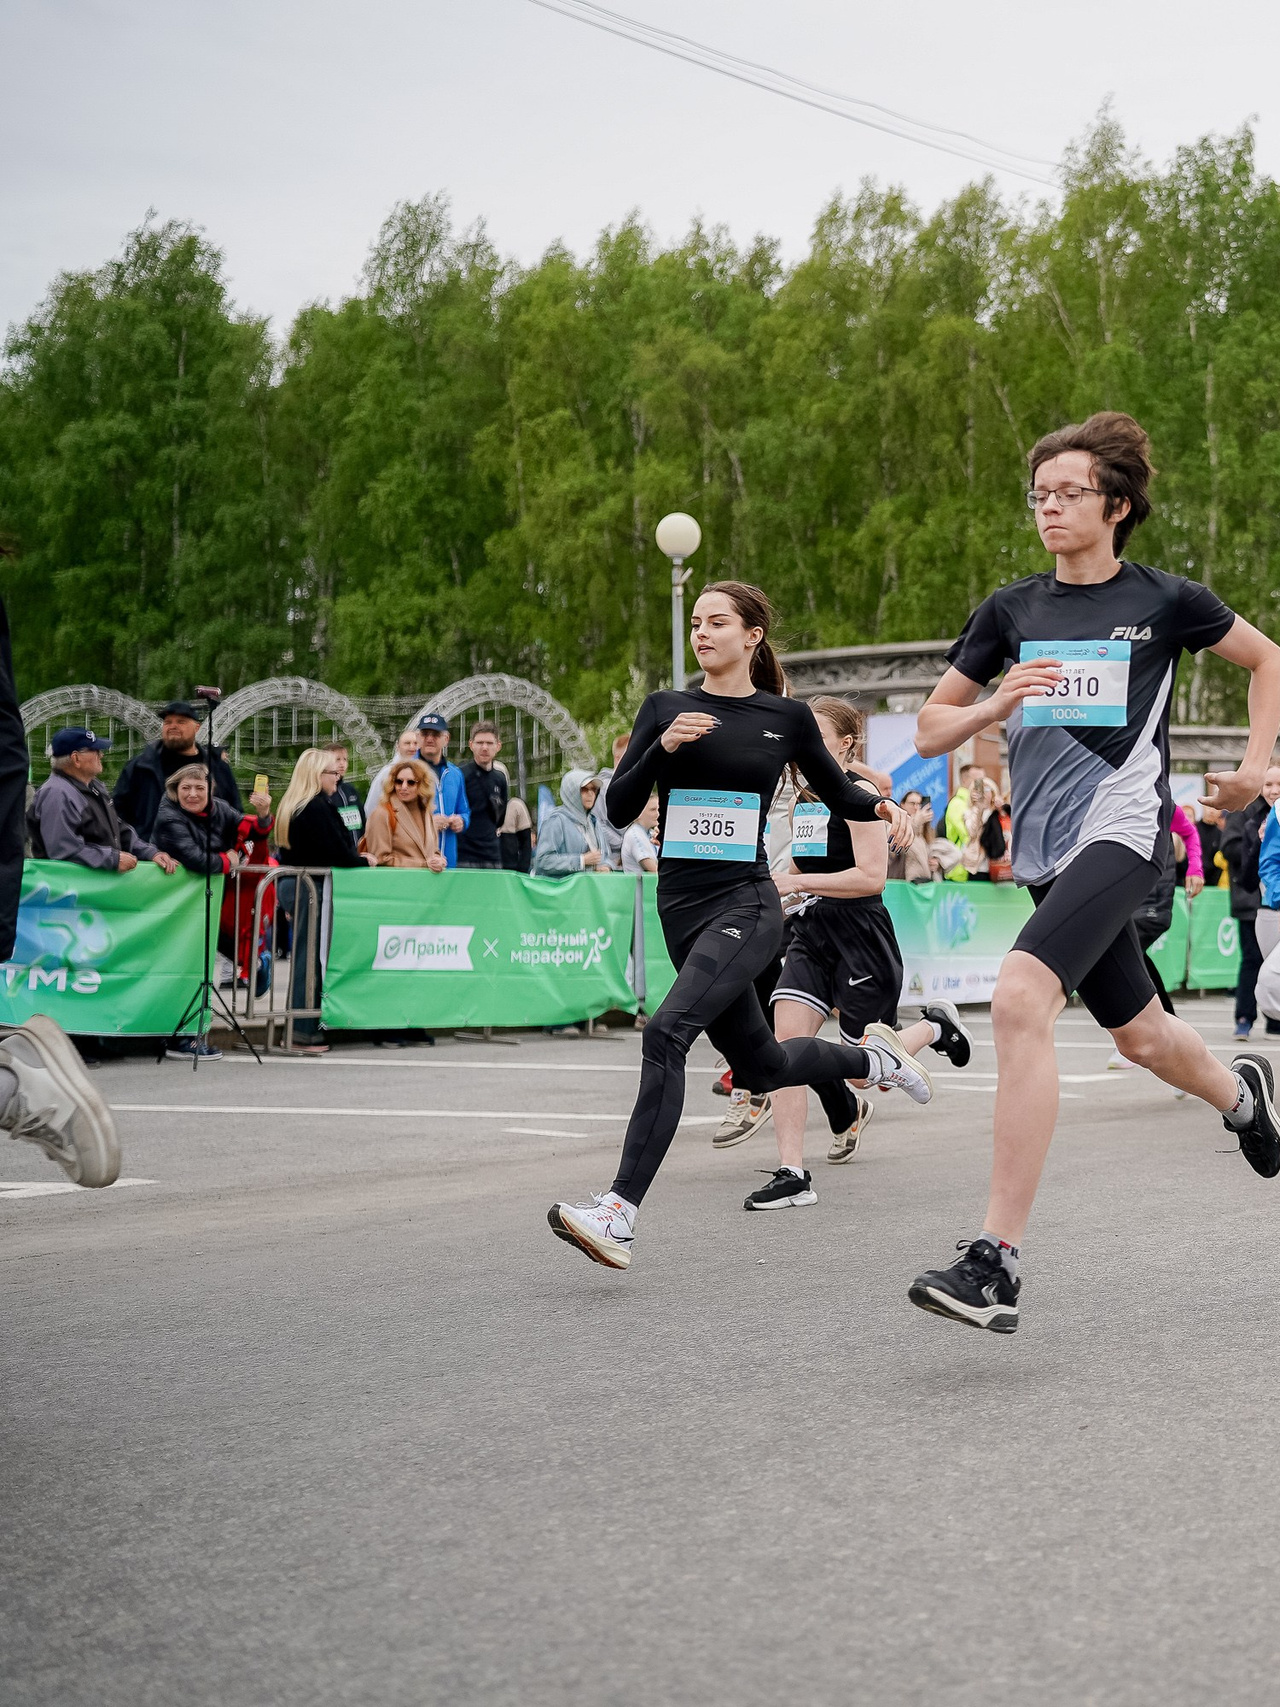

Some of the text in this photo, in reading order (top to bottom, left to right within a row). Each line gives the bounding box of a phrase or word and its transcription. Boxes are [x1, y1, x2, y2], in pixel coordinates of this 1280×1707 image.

[1109, 626, 1152, 640] FILA
[689, 819, 735, 837] 3305
[796, 824, 814, 839] 3333
[520, 928, 588, 947] зелёный
[403, 937, 459, 959] Прайм
[511, 946, 584, 967] марафон
[997, 1240, 1019, 1260] FIL
